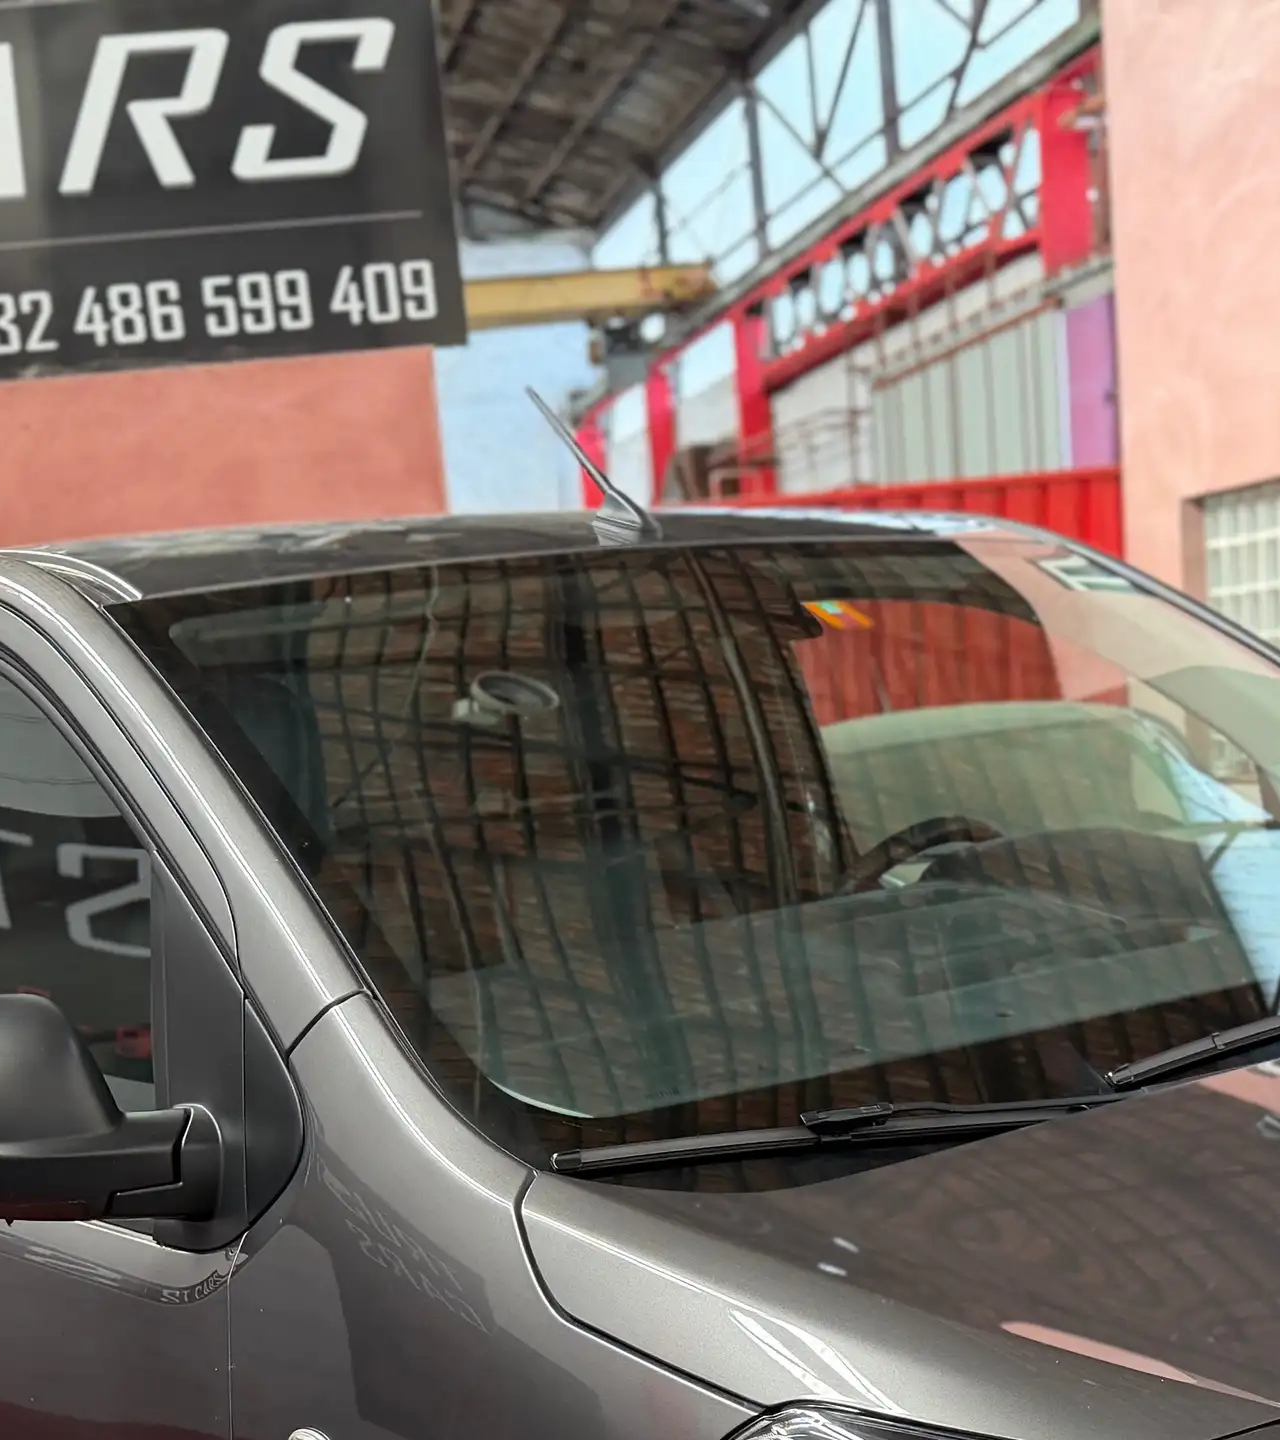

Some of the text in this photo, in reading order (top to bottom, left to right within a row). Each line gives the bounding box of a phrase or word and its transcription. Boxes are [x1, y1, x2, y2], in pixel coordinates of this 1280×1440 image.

[73, 280, 186, 347] 486
[200, 269, 314, 338] 599
[329, 259, 438, 326] 409
